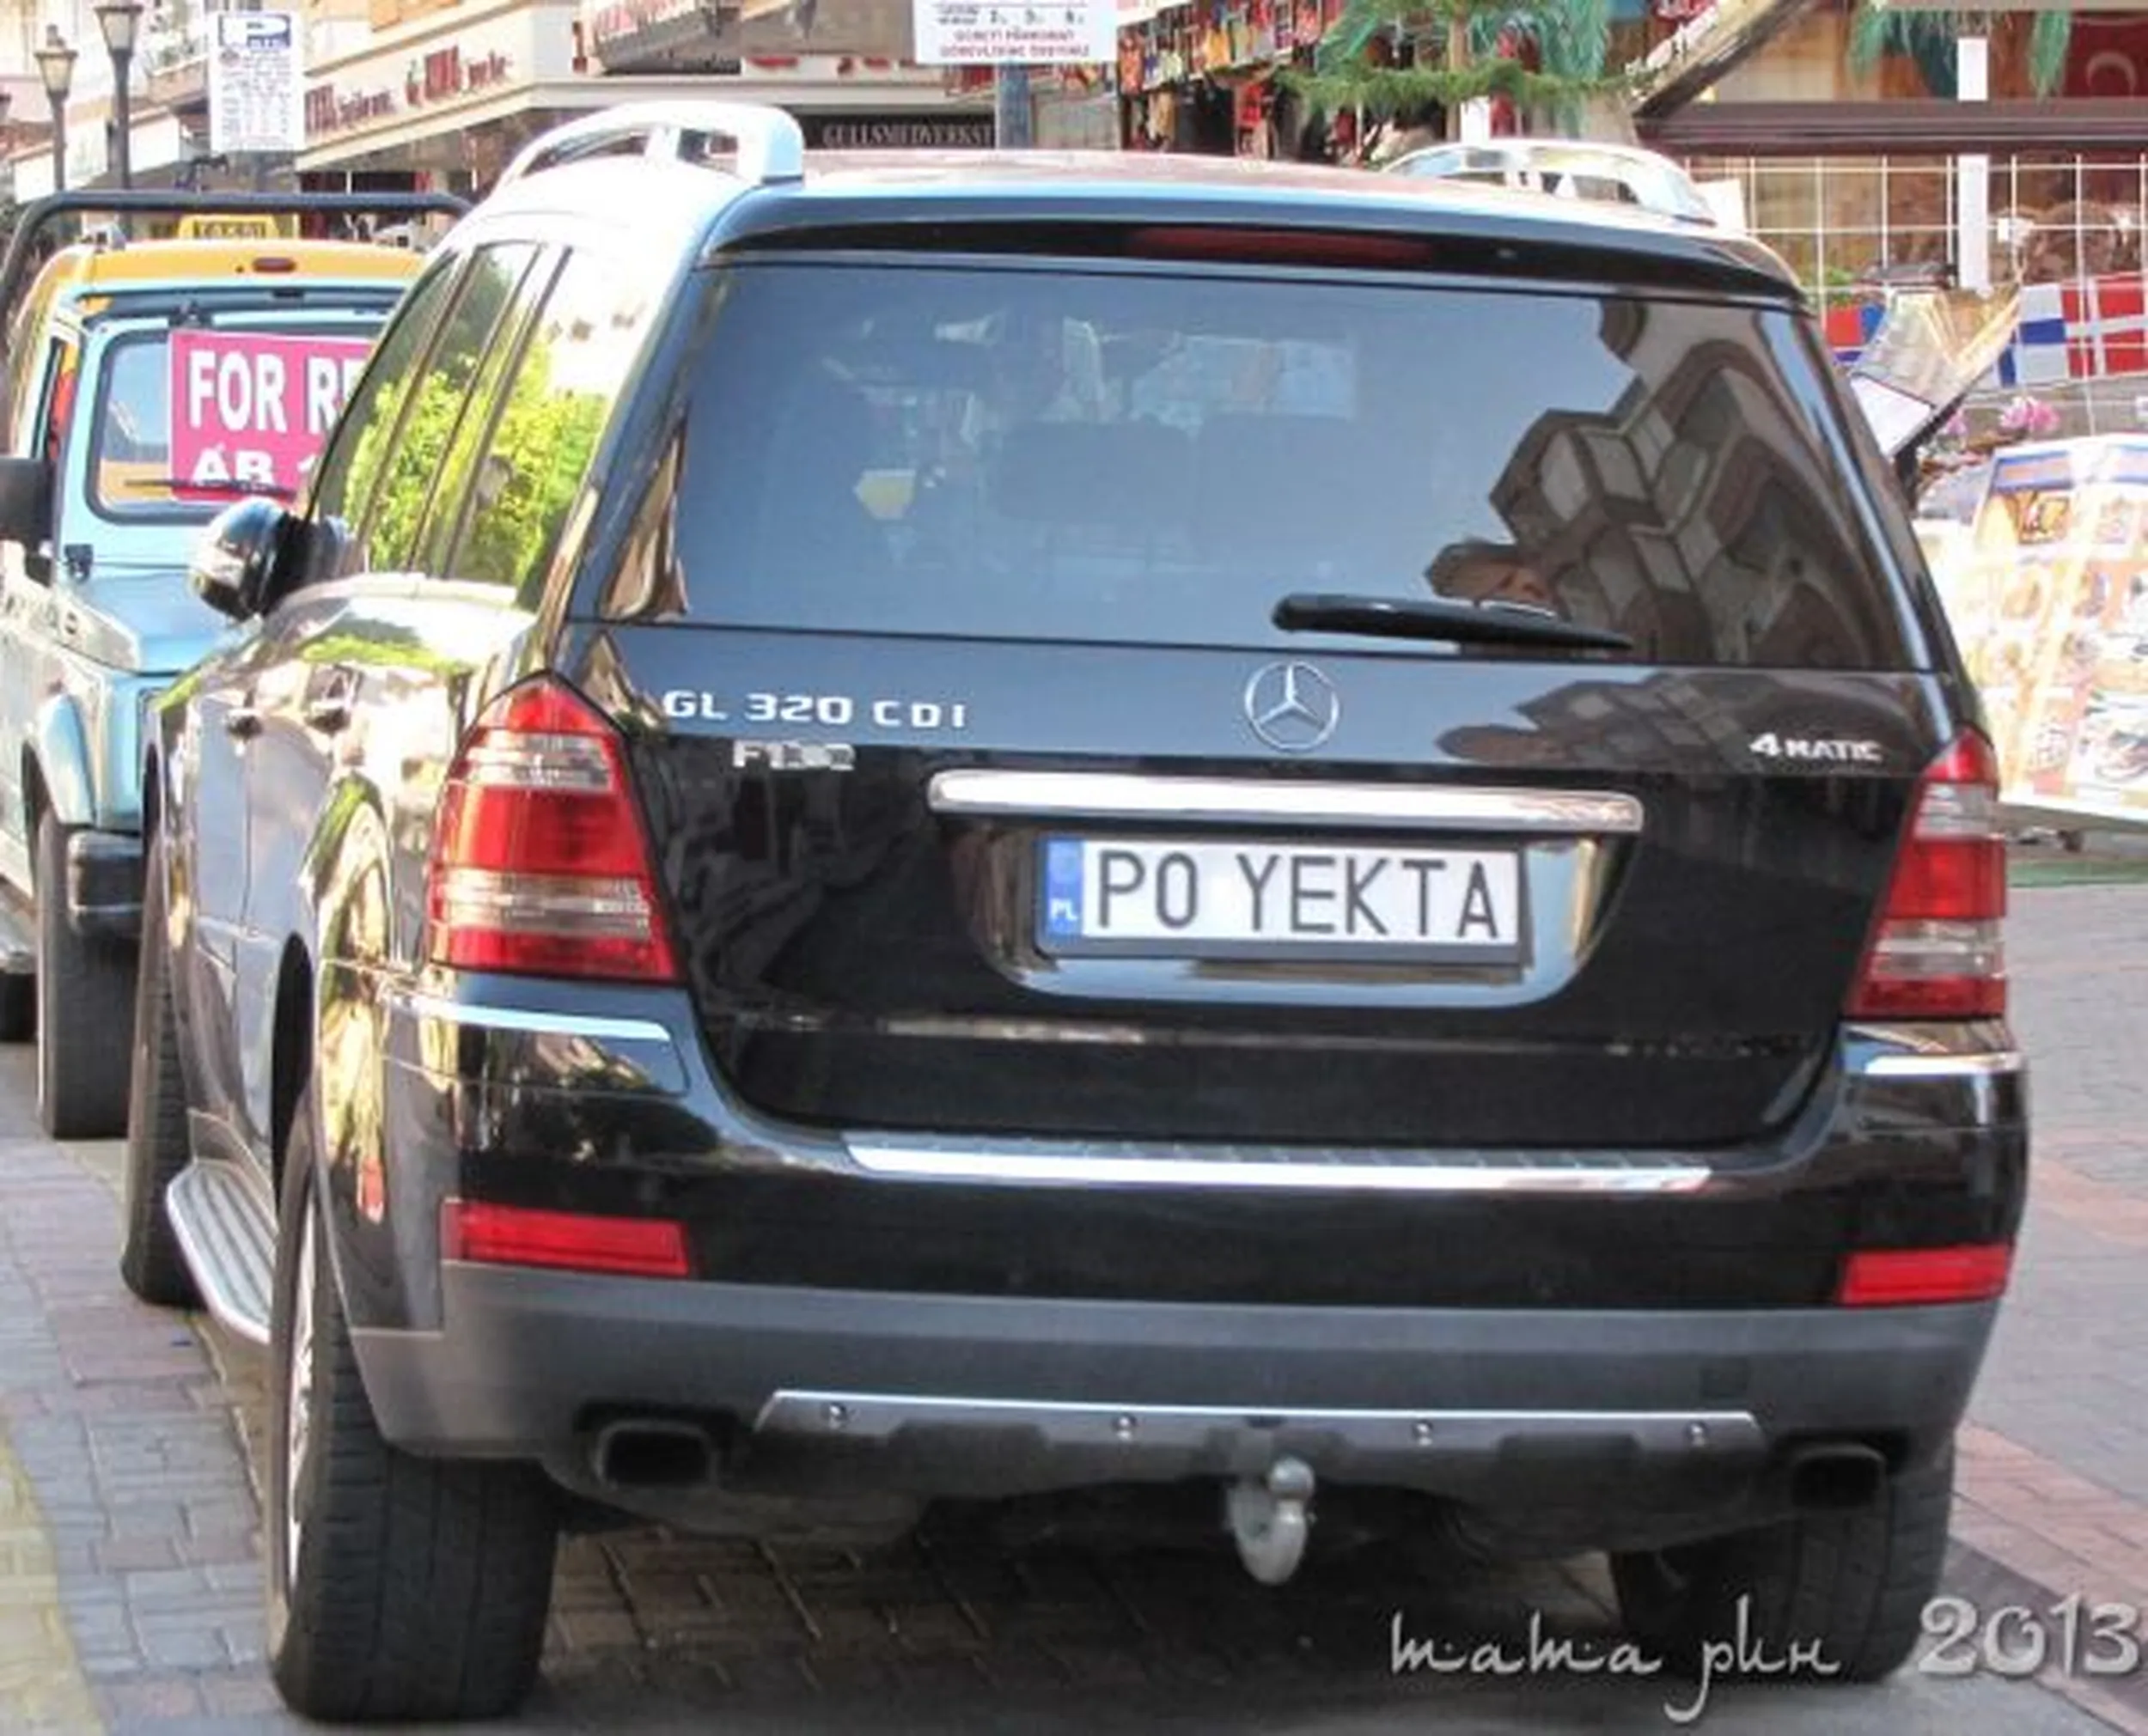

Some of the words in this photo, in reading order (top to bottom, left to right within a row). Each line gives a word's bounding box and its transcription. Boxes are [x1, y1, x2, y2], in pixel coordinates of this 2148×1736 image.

[190, 350, 287, 433] FOR
[662, 690, 727, 720] GL
[745, 693, 853, 725] 320
[873, 700, 967, 728] CDI
[1236, 853, 1498, 940] YEKTA
